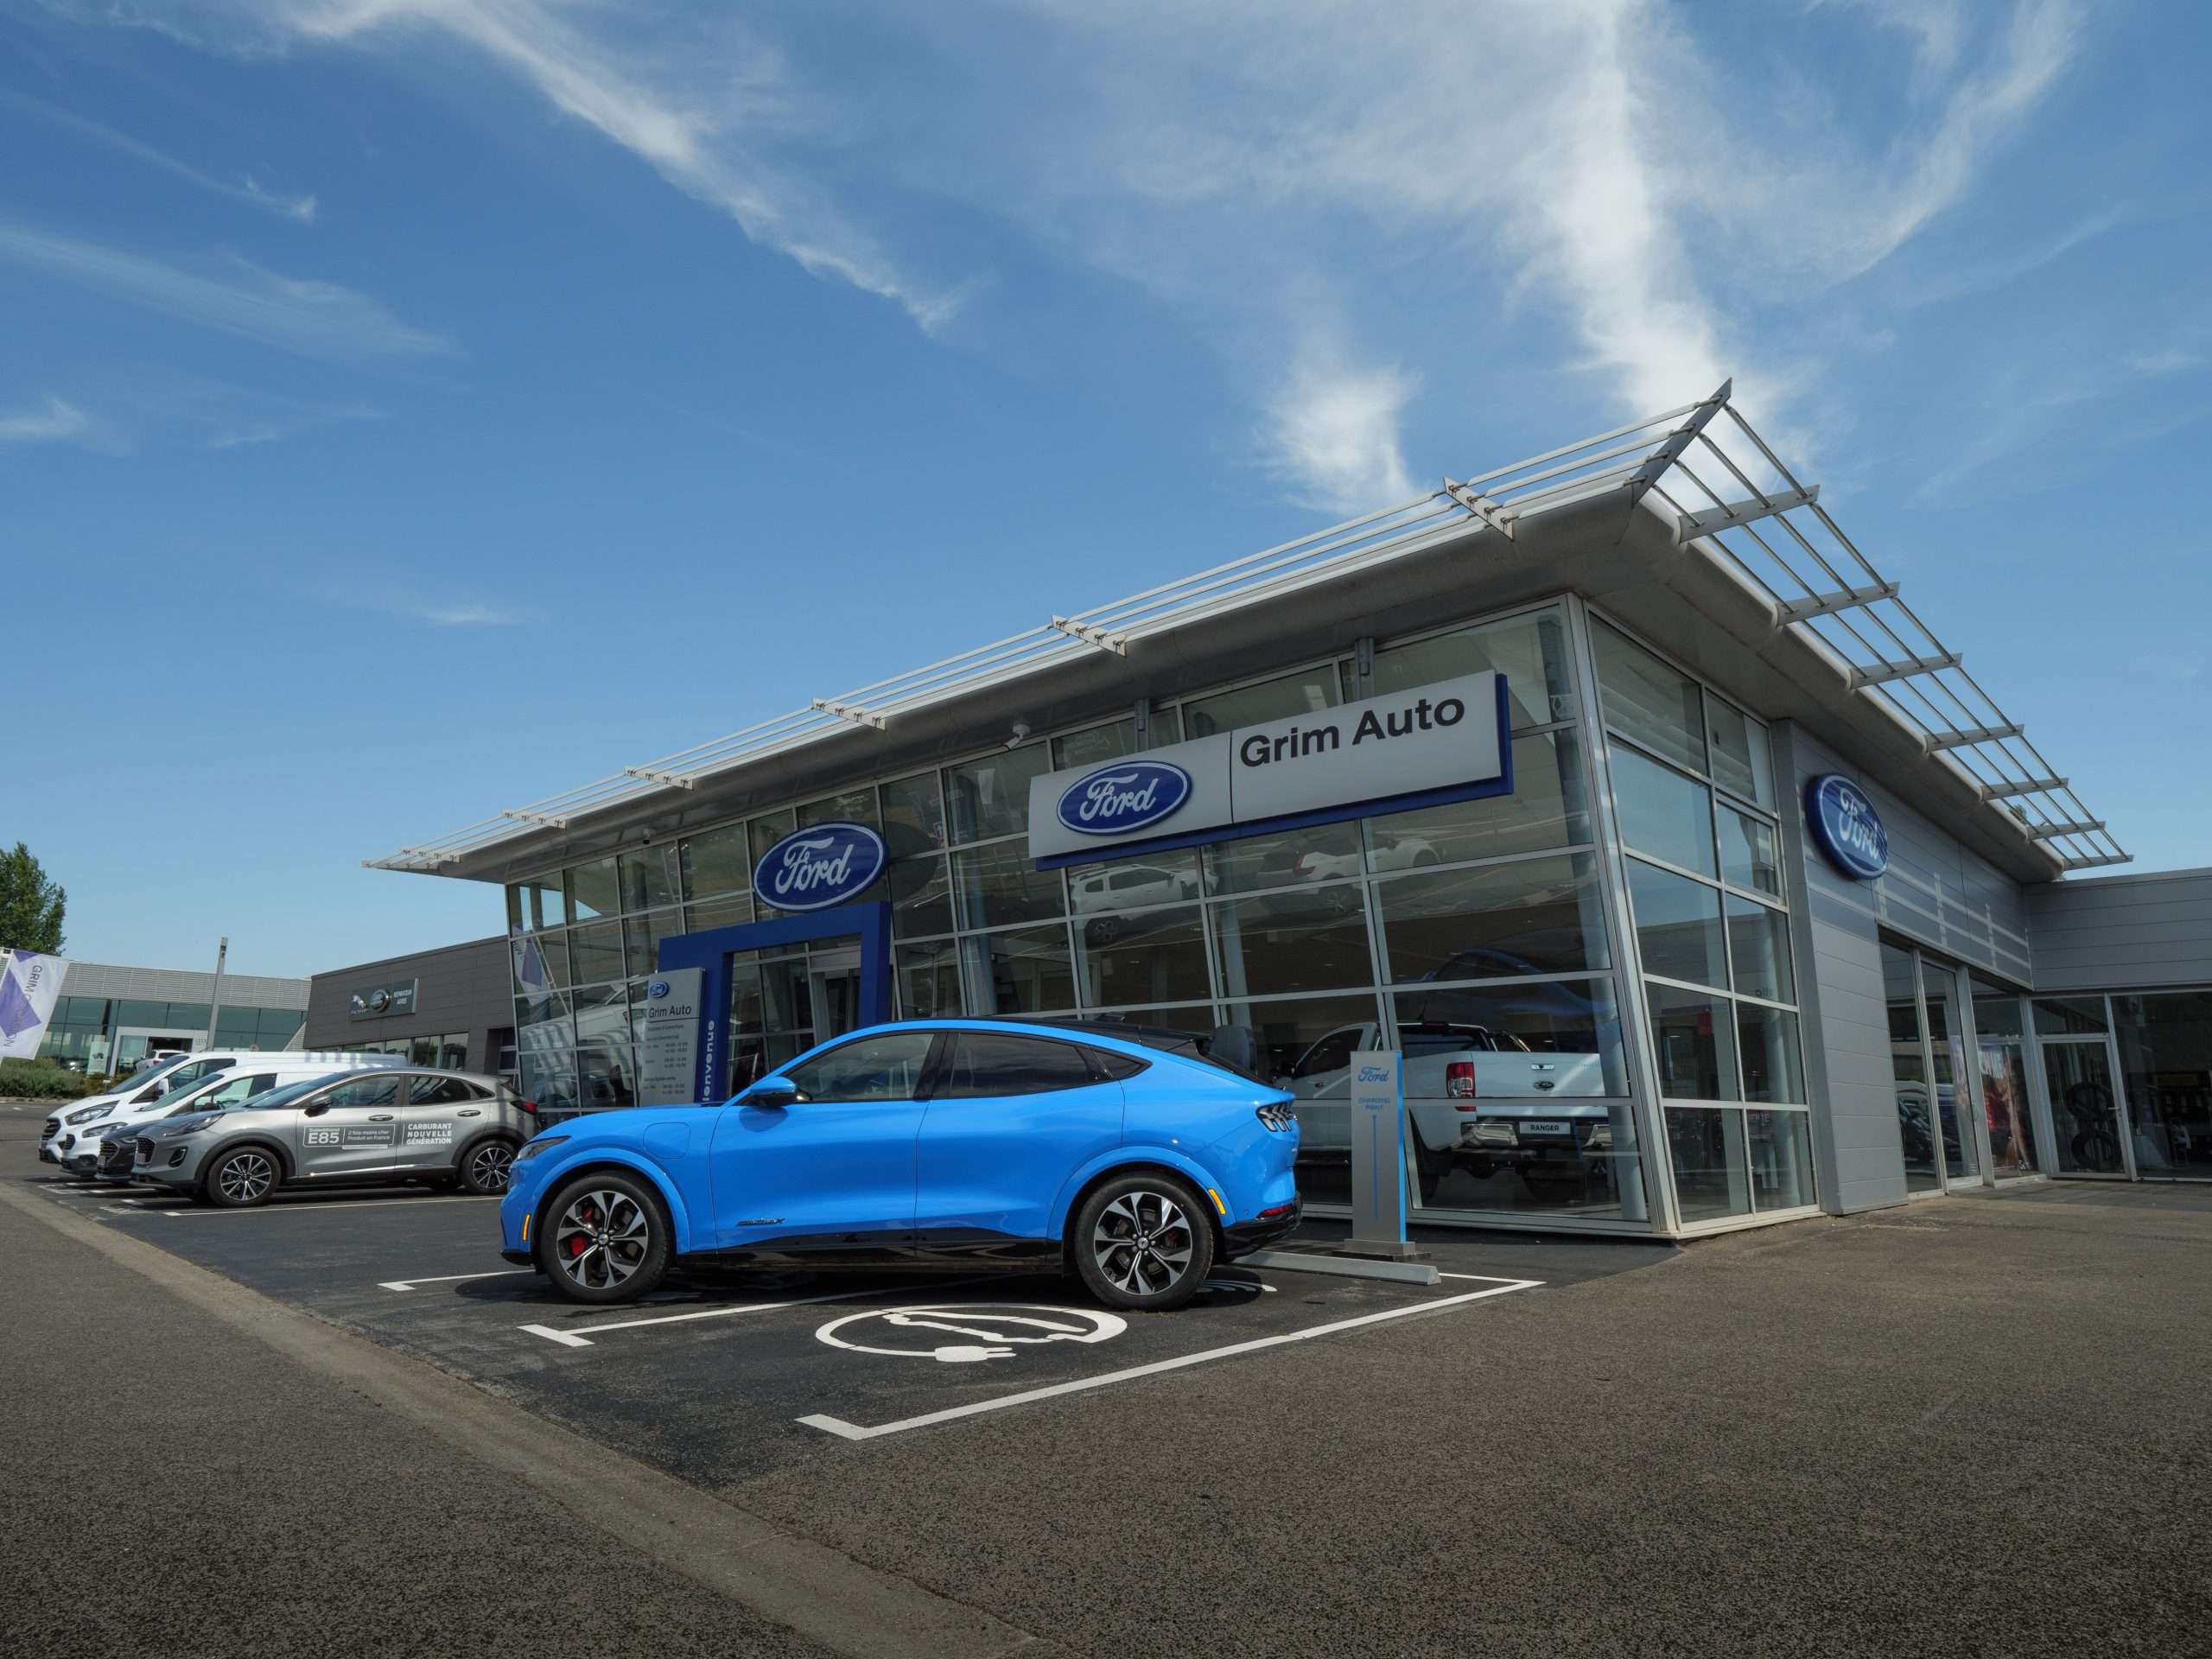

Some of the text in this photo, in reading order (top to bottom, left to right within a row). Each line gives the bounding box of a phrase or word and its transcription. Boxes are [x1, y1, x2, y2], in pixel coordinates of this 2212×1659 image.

[1239, 698, 1465, 767] Grim Auto
[1079, 772, 1160, 822] Ford
[1838, 787, 1880, 860] Ford
[774, 836, 855, 894] Ford
[24, 964, 42, 994] GRIM
[649, 1004, 692, 1018] Grim Auto
[702, 1020, 715, 1102] ienvenue
[1357, 1065, 1389, 1083] Ford
[308, 1132, 340, 1145] E85
[406, 1136, 453, 1145] GÉNÉRATION
